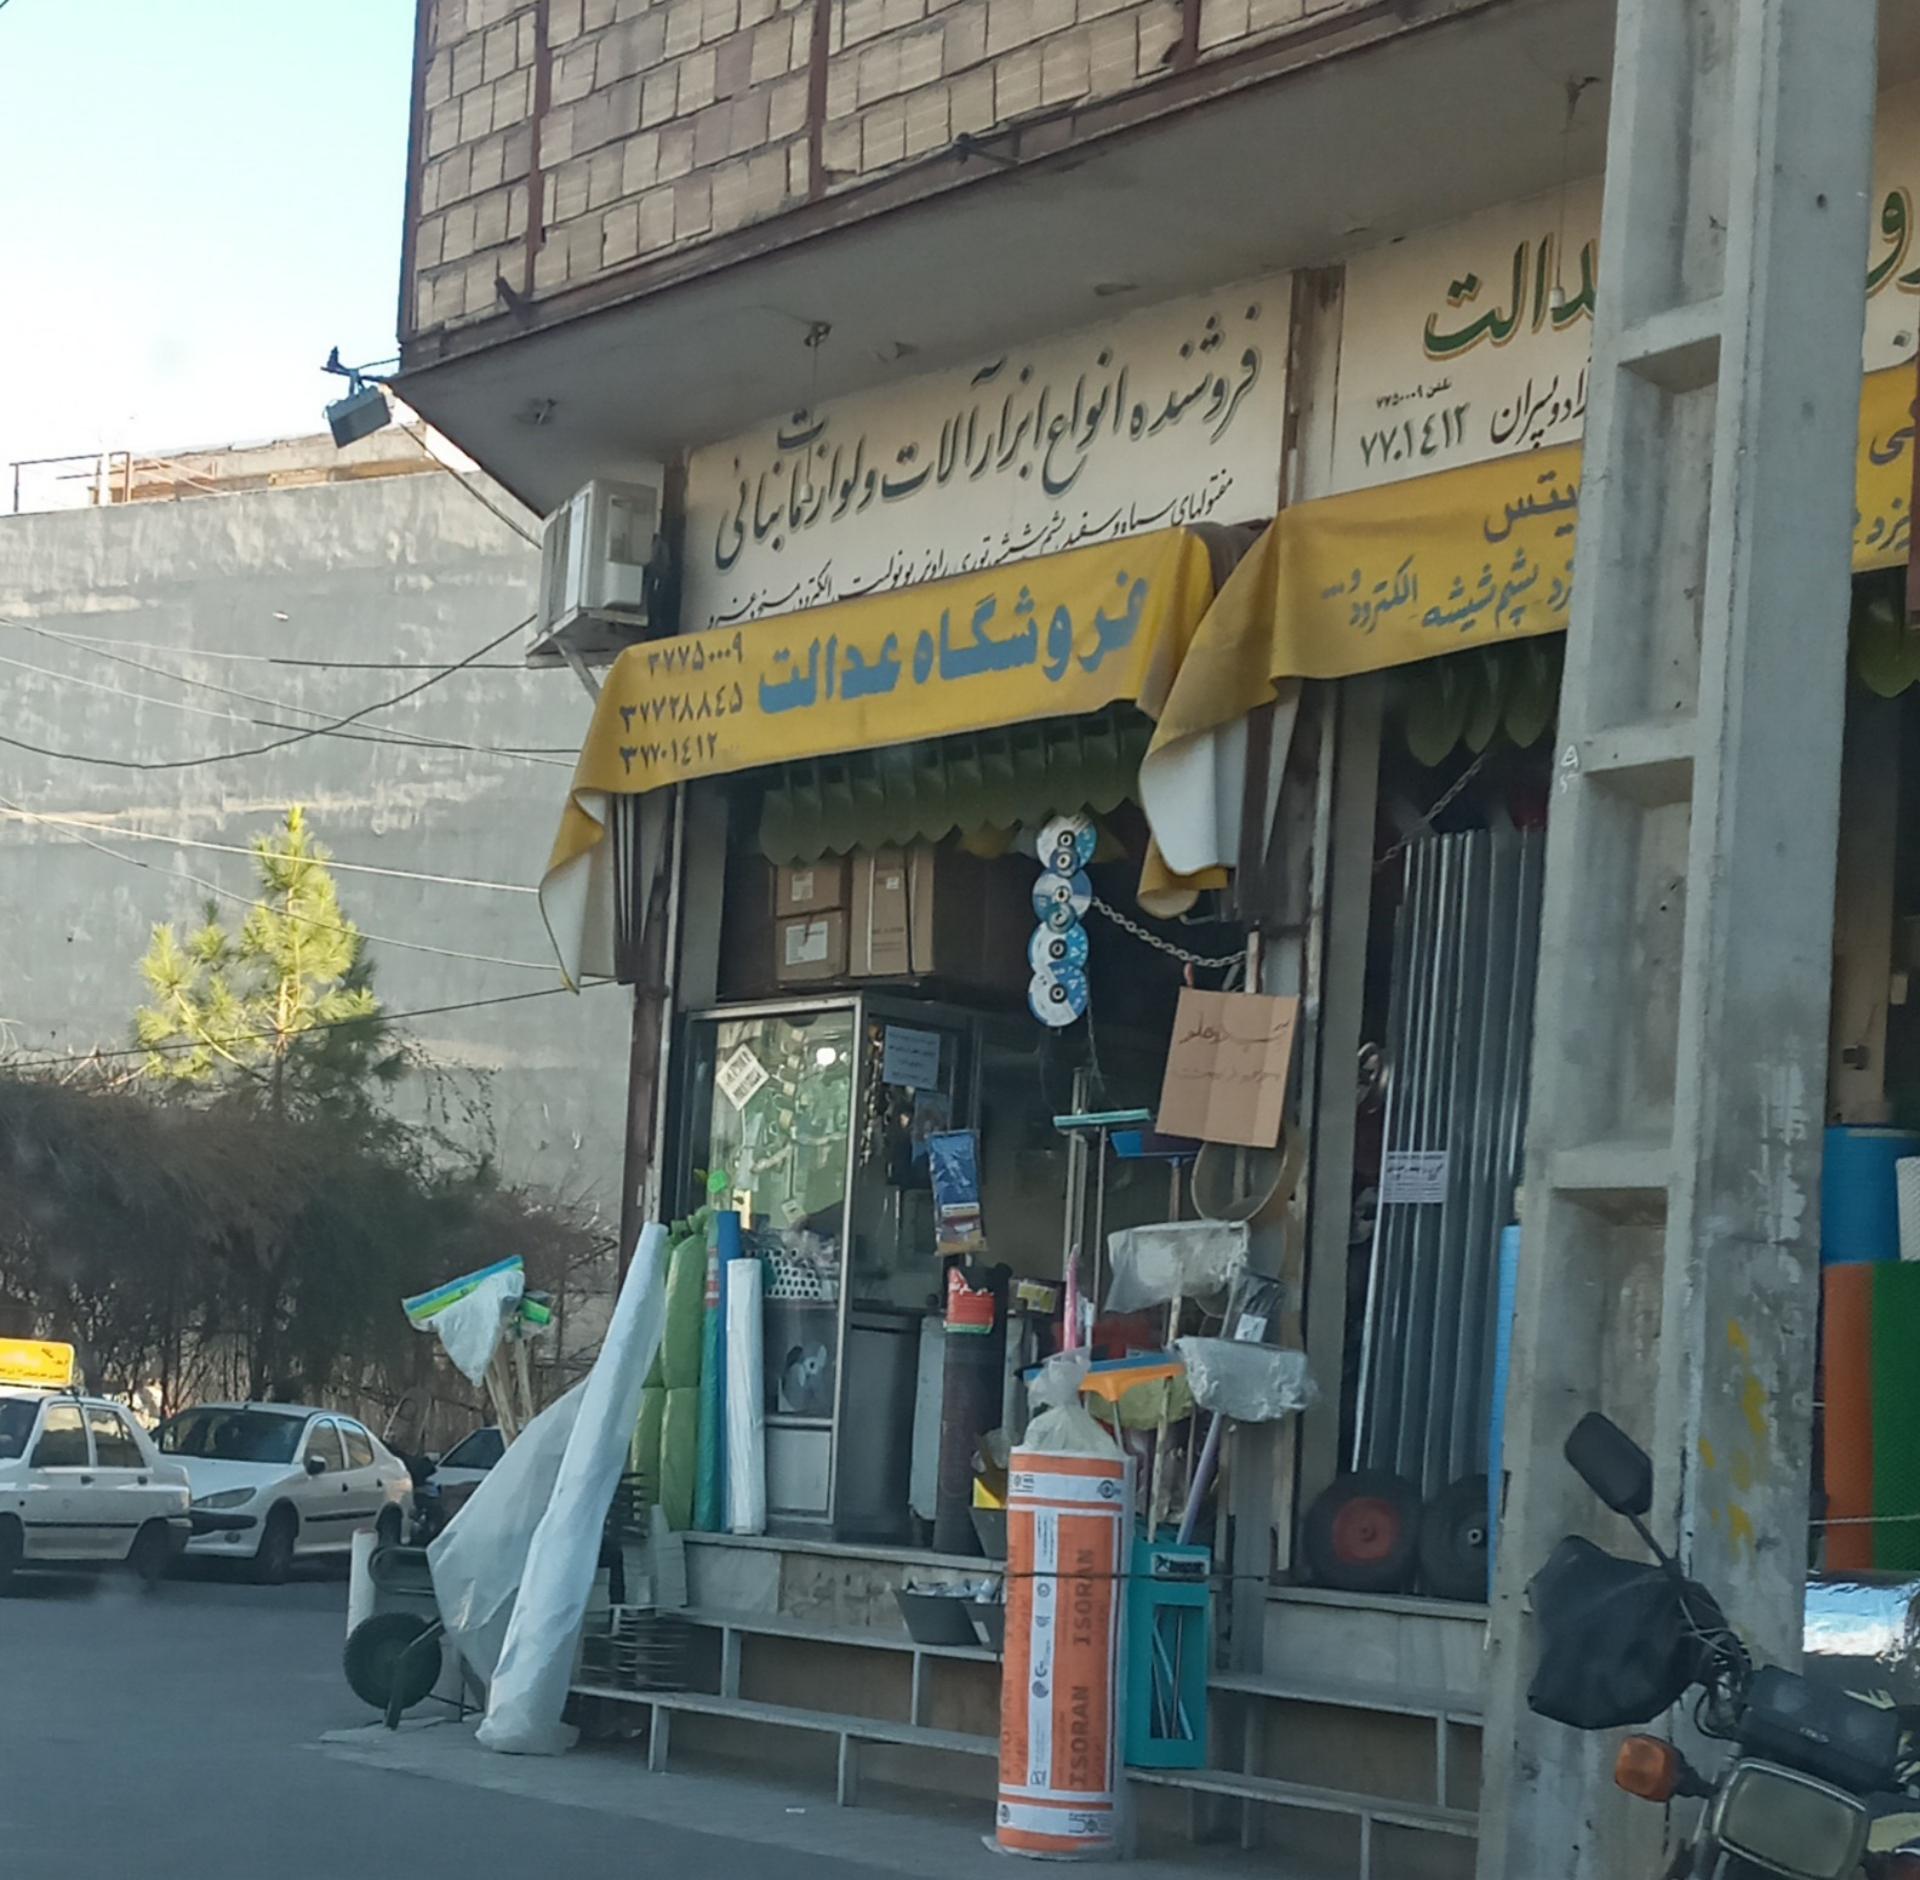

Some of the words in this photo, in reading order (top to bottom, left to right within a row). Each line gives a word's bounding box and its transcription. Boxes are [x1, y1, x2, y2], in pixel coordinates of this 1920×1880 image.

[1423, 233, 1598, 357] دالت
[1042, 350, 1127, 496] انواع
[1129, 304, 1260, 437] فروشنده
[1490, 376, 1559, 448] پسران
[757, 631, 901, 715] عدالت
[912, 568, 1149, 684] فروشگاه
[1074, 1550, 1095, 1648] ISORAN
[1069, 1685, 1090, 1786] ISORAN
